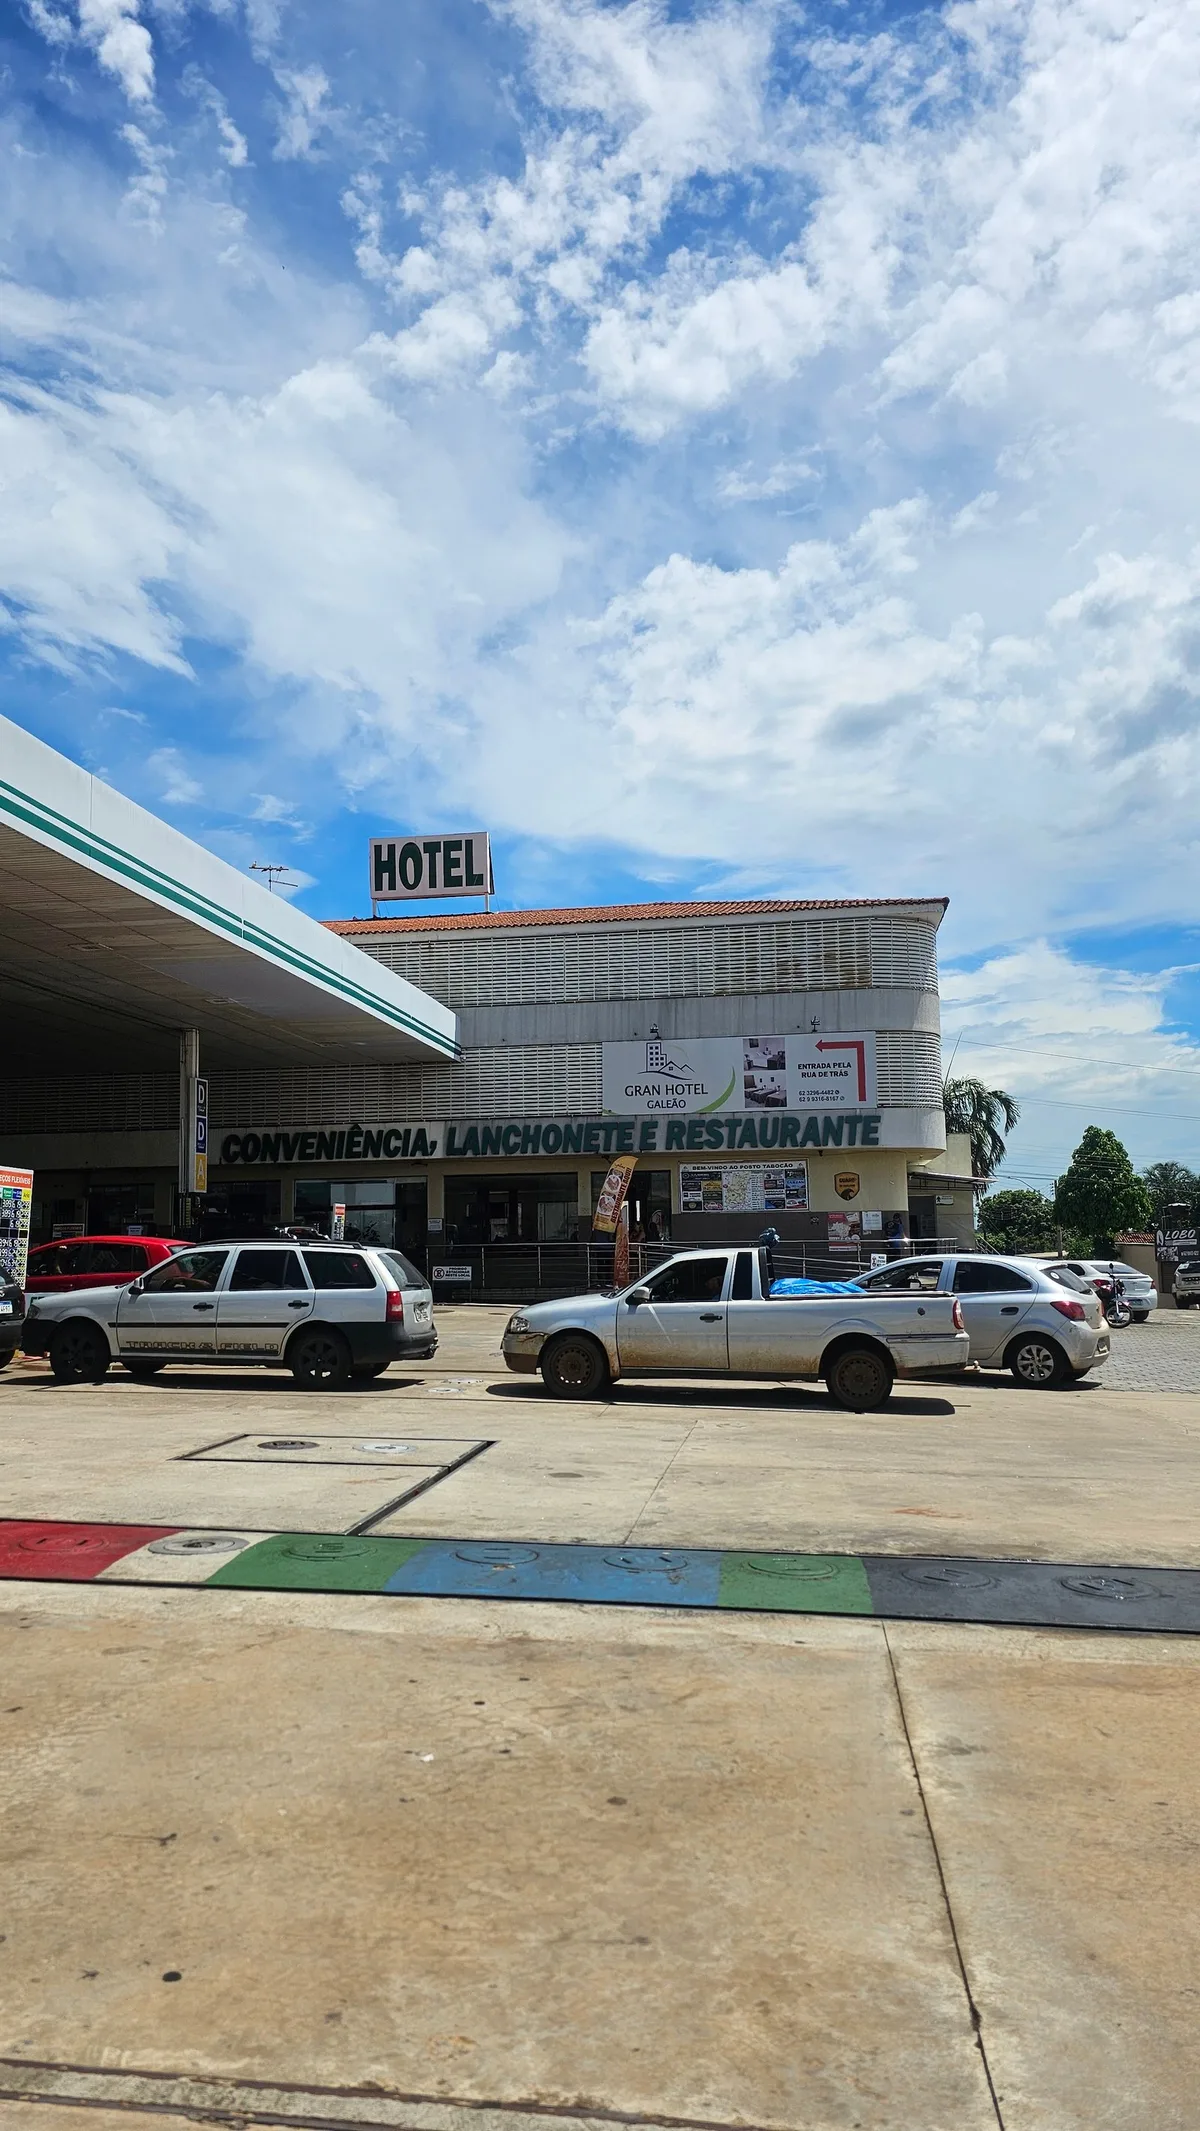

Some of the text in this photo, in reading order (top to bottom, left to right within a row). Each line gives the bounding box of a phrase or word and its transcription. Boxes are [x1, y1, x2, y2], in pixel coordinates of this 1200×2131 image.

[374, 839, 484, 892] HOTEL
[797, 1061, 852, 1070] ENTRADA PELA
[829, 1069, 849, 1078] TRÁS
[198, 1085, 205, 1104] D
[624, 1083, 708, 1097] GRAN HOTEL
[646, 1097, 687, 1109] GALEÃO
[197, 1121, 205, 1141] D
[221, 1115, 881, 1164] CONVENIÊNCIA, LANCHONETE E RESTAURANTE
[197, 1159, 205, 1179] A
[1164, 1229, 1196, 1240] LOBO
[220, 1342, 279, 1350] FIELD
